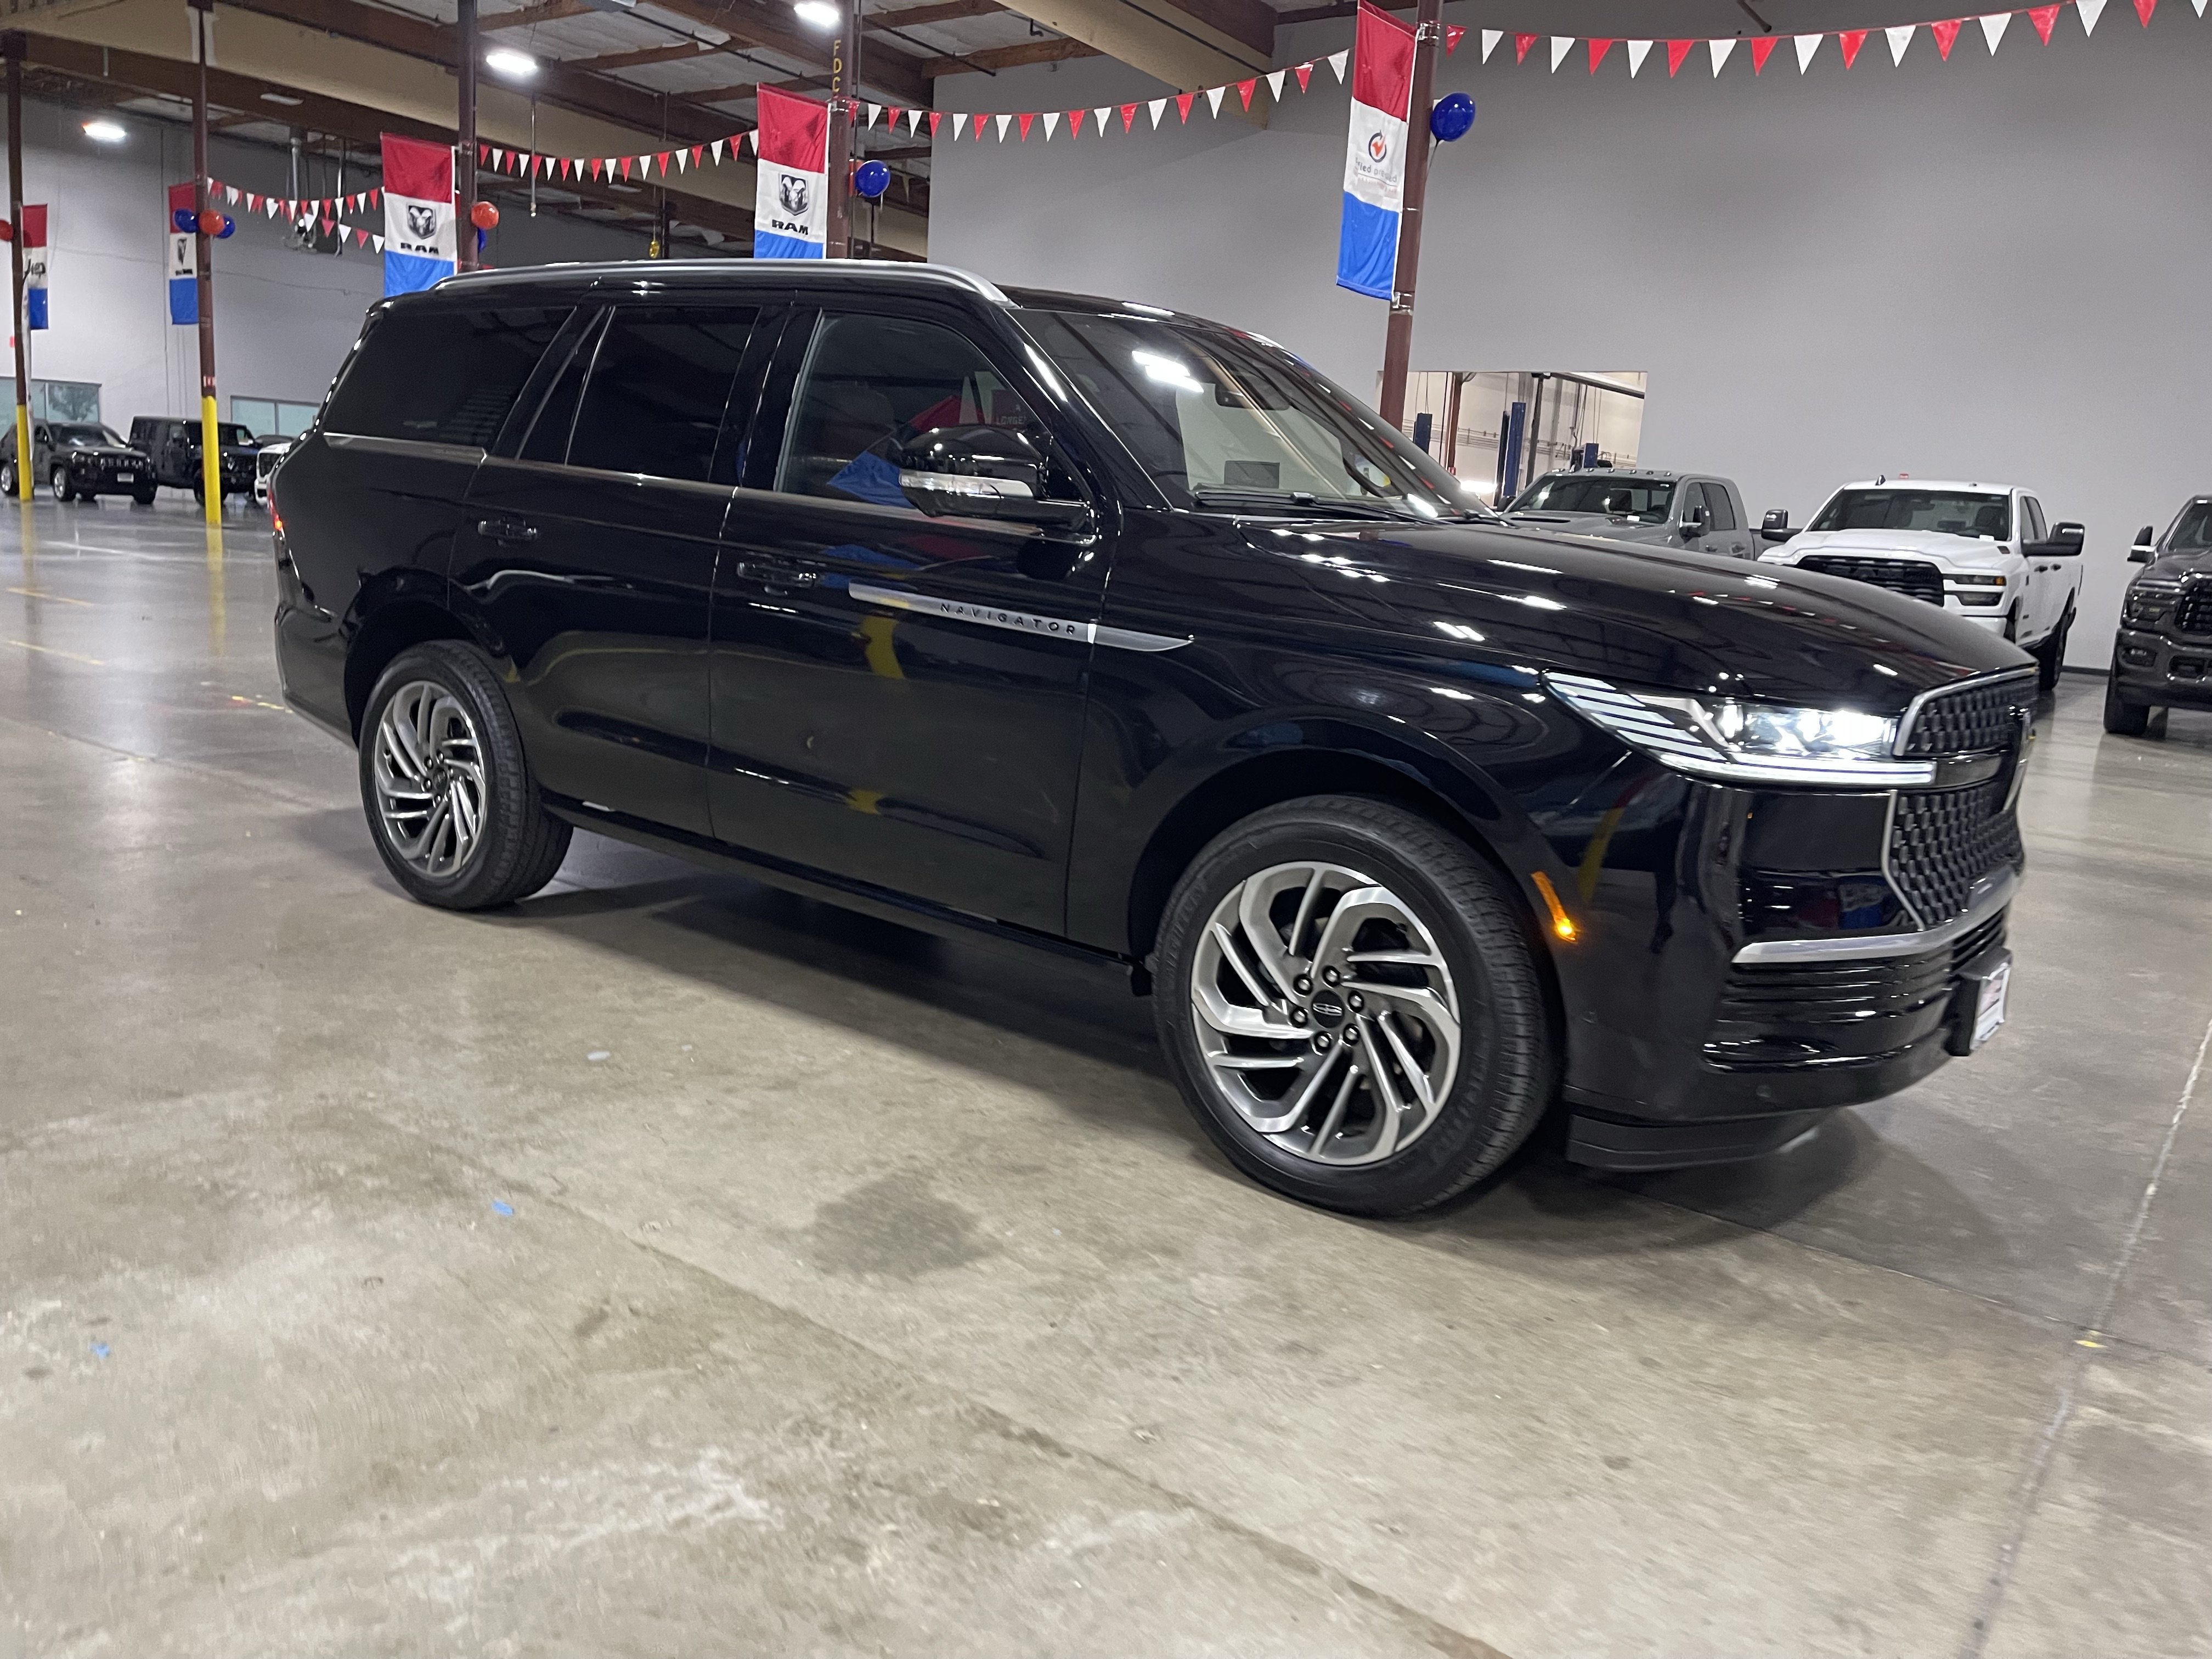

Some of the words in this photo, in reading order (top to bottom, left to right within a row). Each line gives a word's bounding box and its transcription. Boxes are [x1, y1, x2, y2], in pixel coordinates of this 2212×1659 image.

[832, 40, 842, 92] FDC
[772, 219, 809, 235] RAM
[400, 242, 439, 255] RAM
[940, 603, 1075, 635] NAVIGATOR
